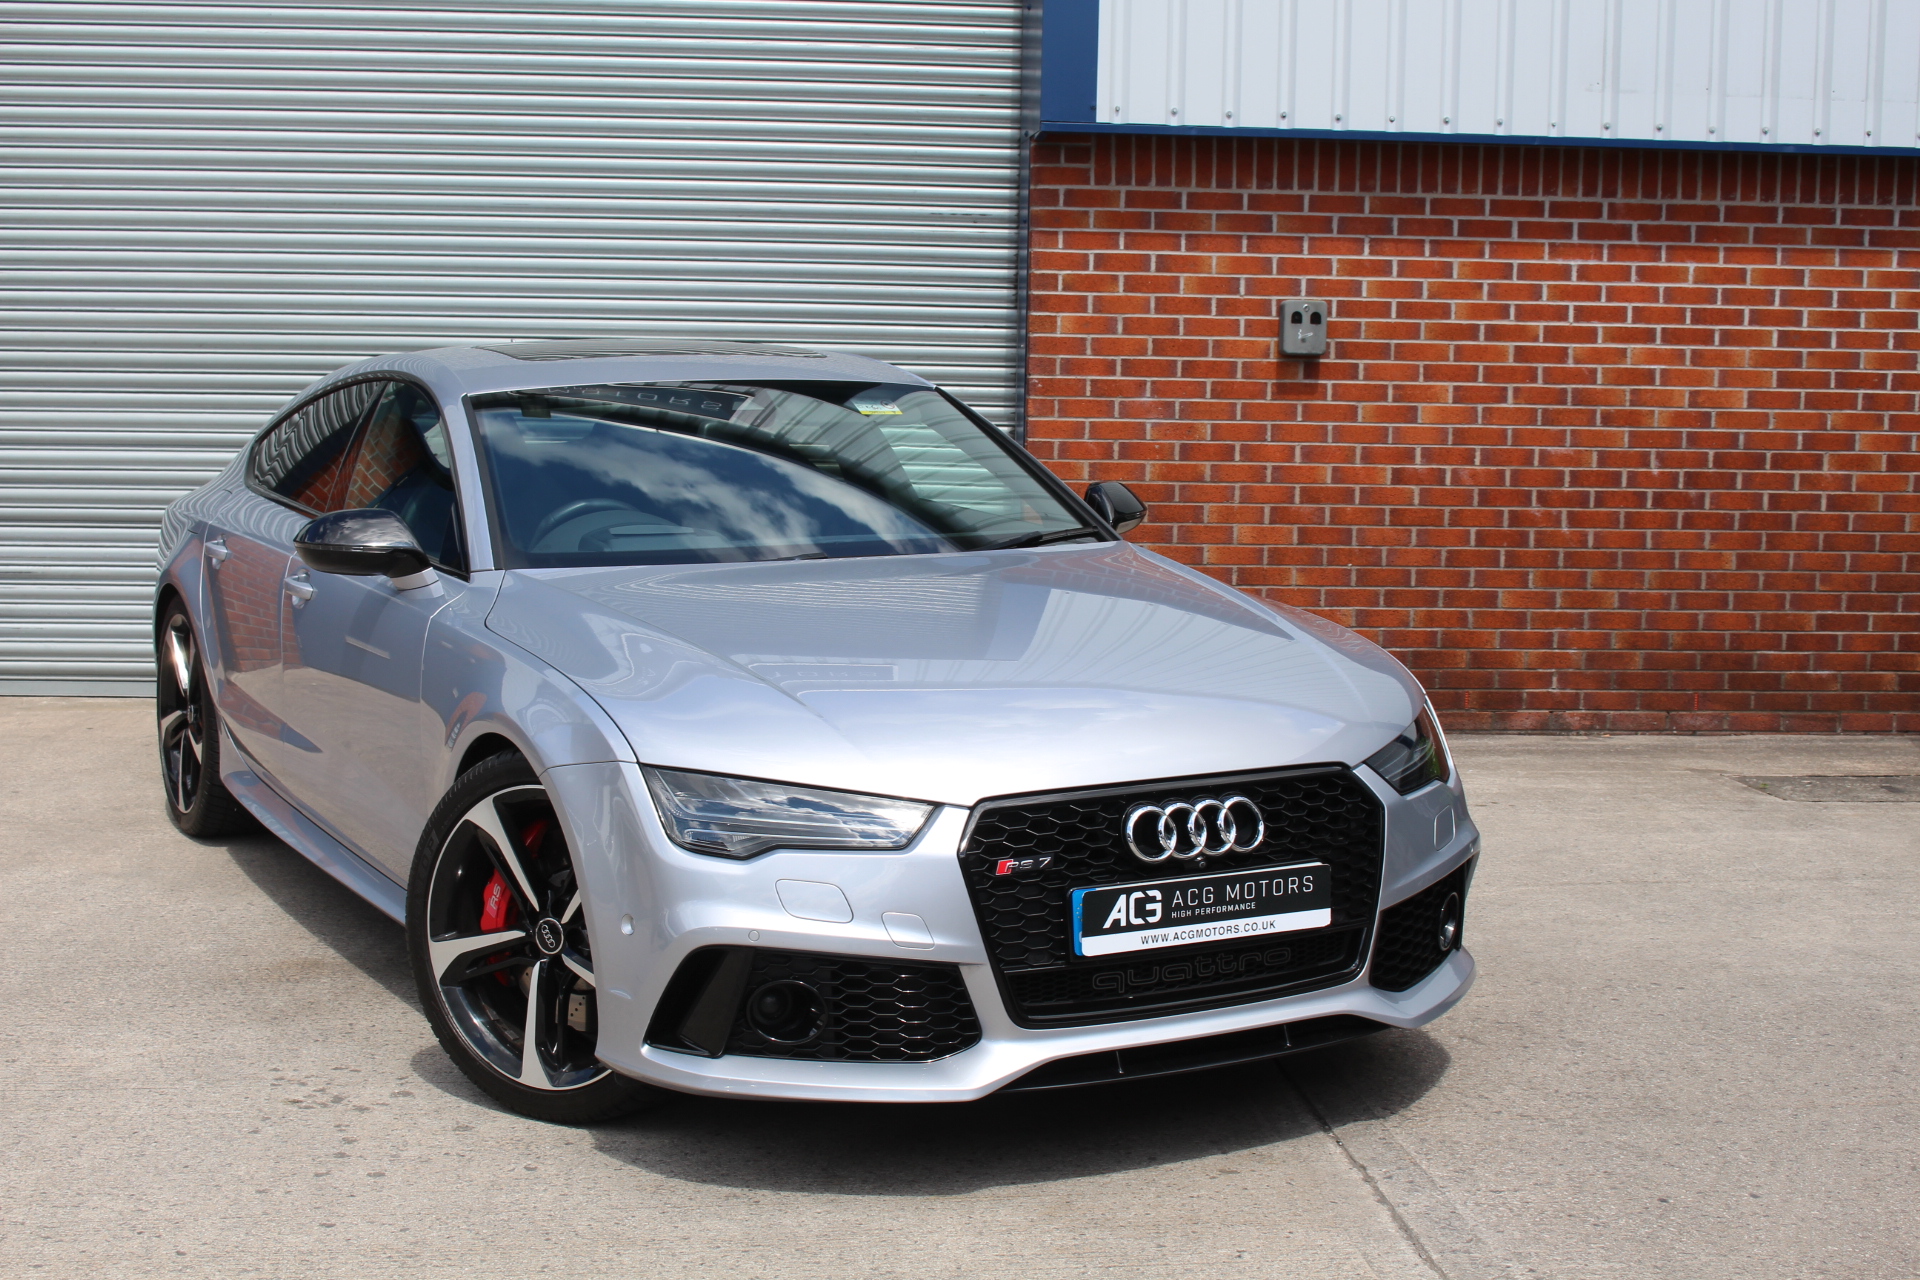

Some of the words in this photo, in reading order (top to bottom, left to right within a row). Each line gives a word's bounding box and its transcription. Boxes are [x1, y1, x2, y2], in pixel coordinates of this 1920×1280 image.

[1171, 886, 1215, 908] ACG
[1225, 875, 1315, 902] MOTORS
[1102, 889, 1163, 929] ACG
[1171, 910, 1192, 919] HIGH
[1195, 901, 1257, 916] PERFORMANCE
[1140, 919, 1277, 945] WWW.ACGMOTORS.CO.UK
[1092, 947, 1292, 994] quattro
